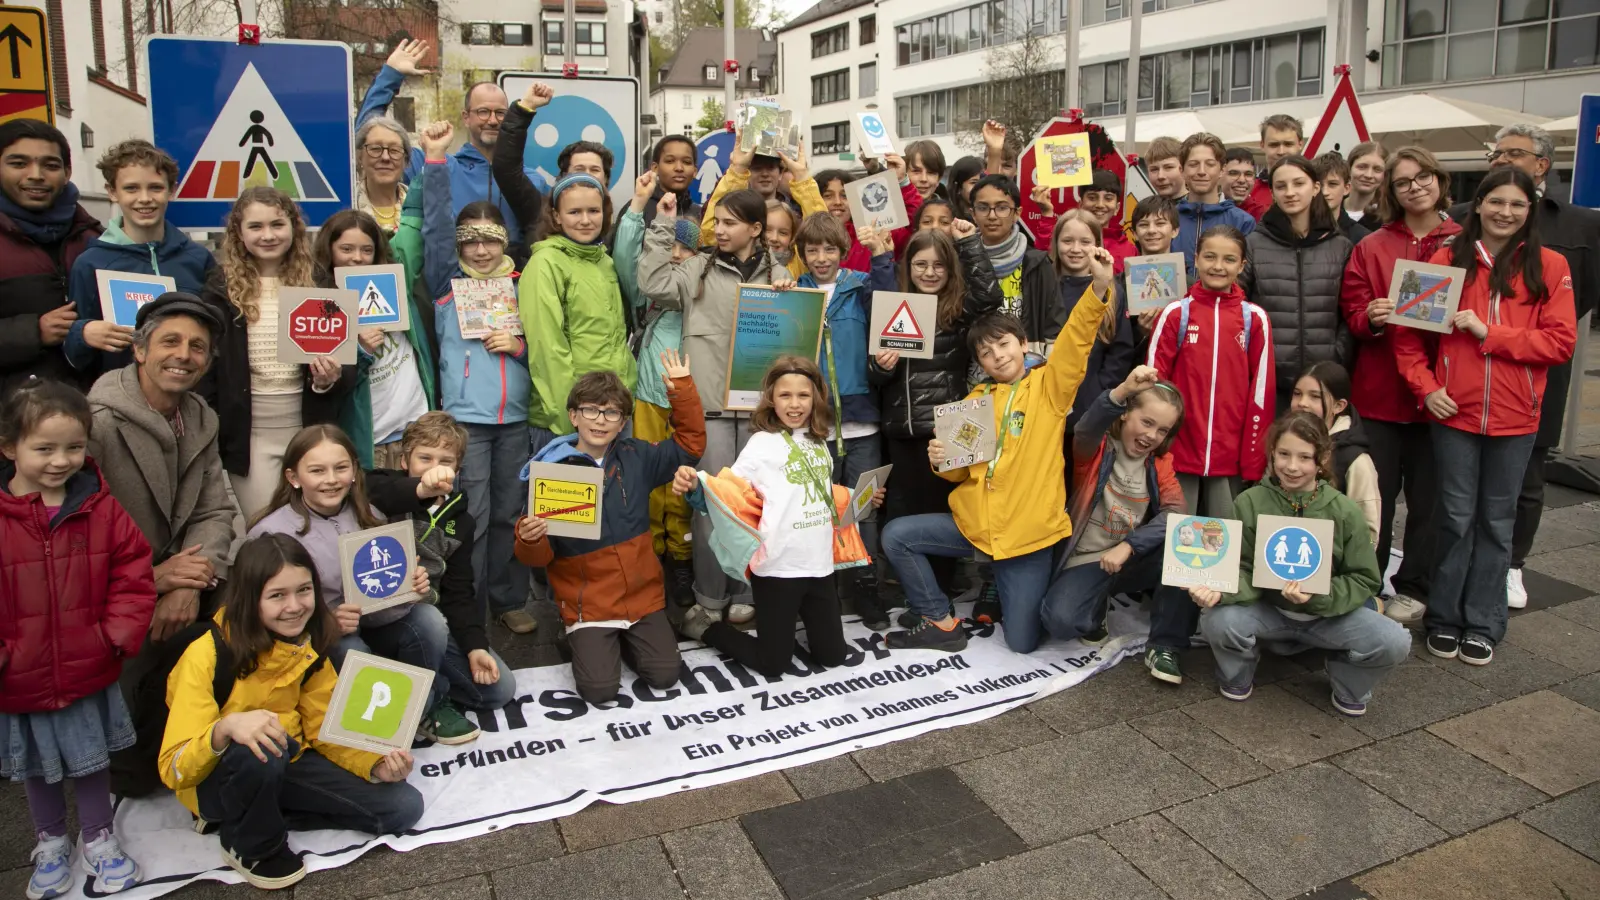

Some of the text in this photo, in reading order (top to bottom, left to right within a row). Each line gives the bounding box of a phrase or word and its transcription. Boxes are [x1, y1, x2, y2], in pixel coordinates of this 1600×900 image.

[126, 292, 154, 301] KRIEG
[742, 290, 780, 298] 2026/2027
[740, 312, 766, 320] Bildung
[295, 316, 343, 333] STOP
[738, 319, 779, 329] nachhaltige
[737, 326, 780, 336] Entwicklung
[886, 340, 904, 348] SCHAU
[780, 461, 802, 476] THE
[546, 487, 585, 496] Gleichbehandlung
[539, 504, 591, 517] Rassismus
[803, 510, 822, 519] Trees
[792, 519, 822, 530] Climate
[605, 721, 653, 741] für
[752, 653, 971, 712] Zusammenleben
[682, 742, 724, 761] Ein
[727, 720, 816, 750] Projekt
[817, 712, 859, 731] von
[861, 688, 960, 720] Johannes
[956, 668, 1054, 695] Volkmann
[1064, 650, 1102, 668] Das
